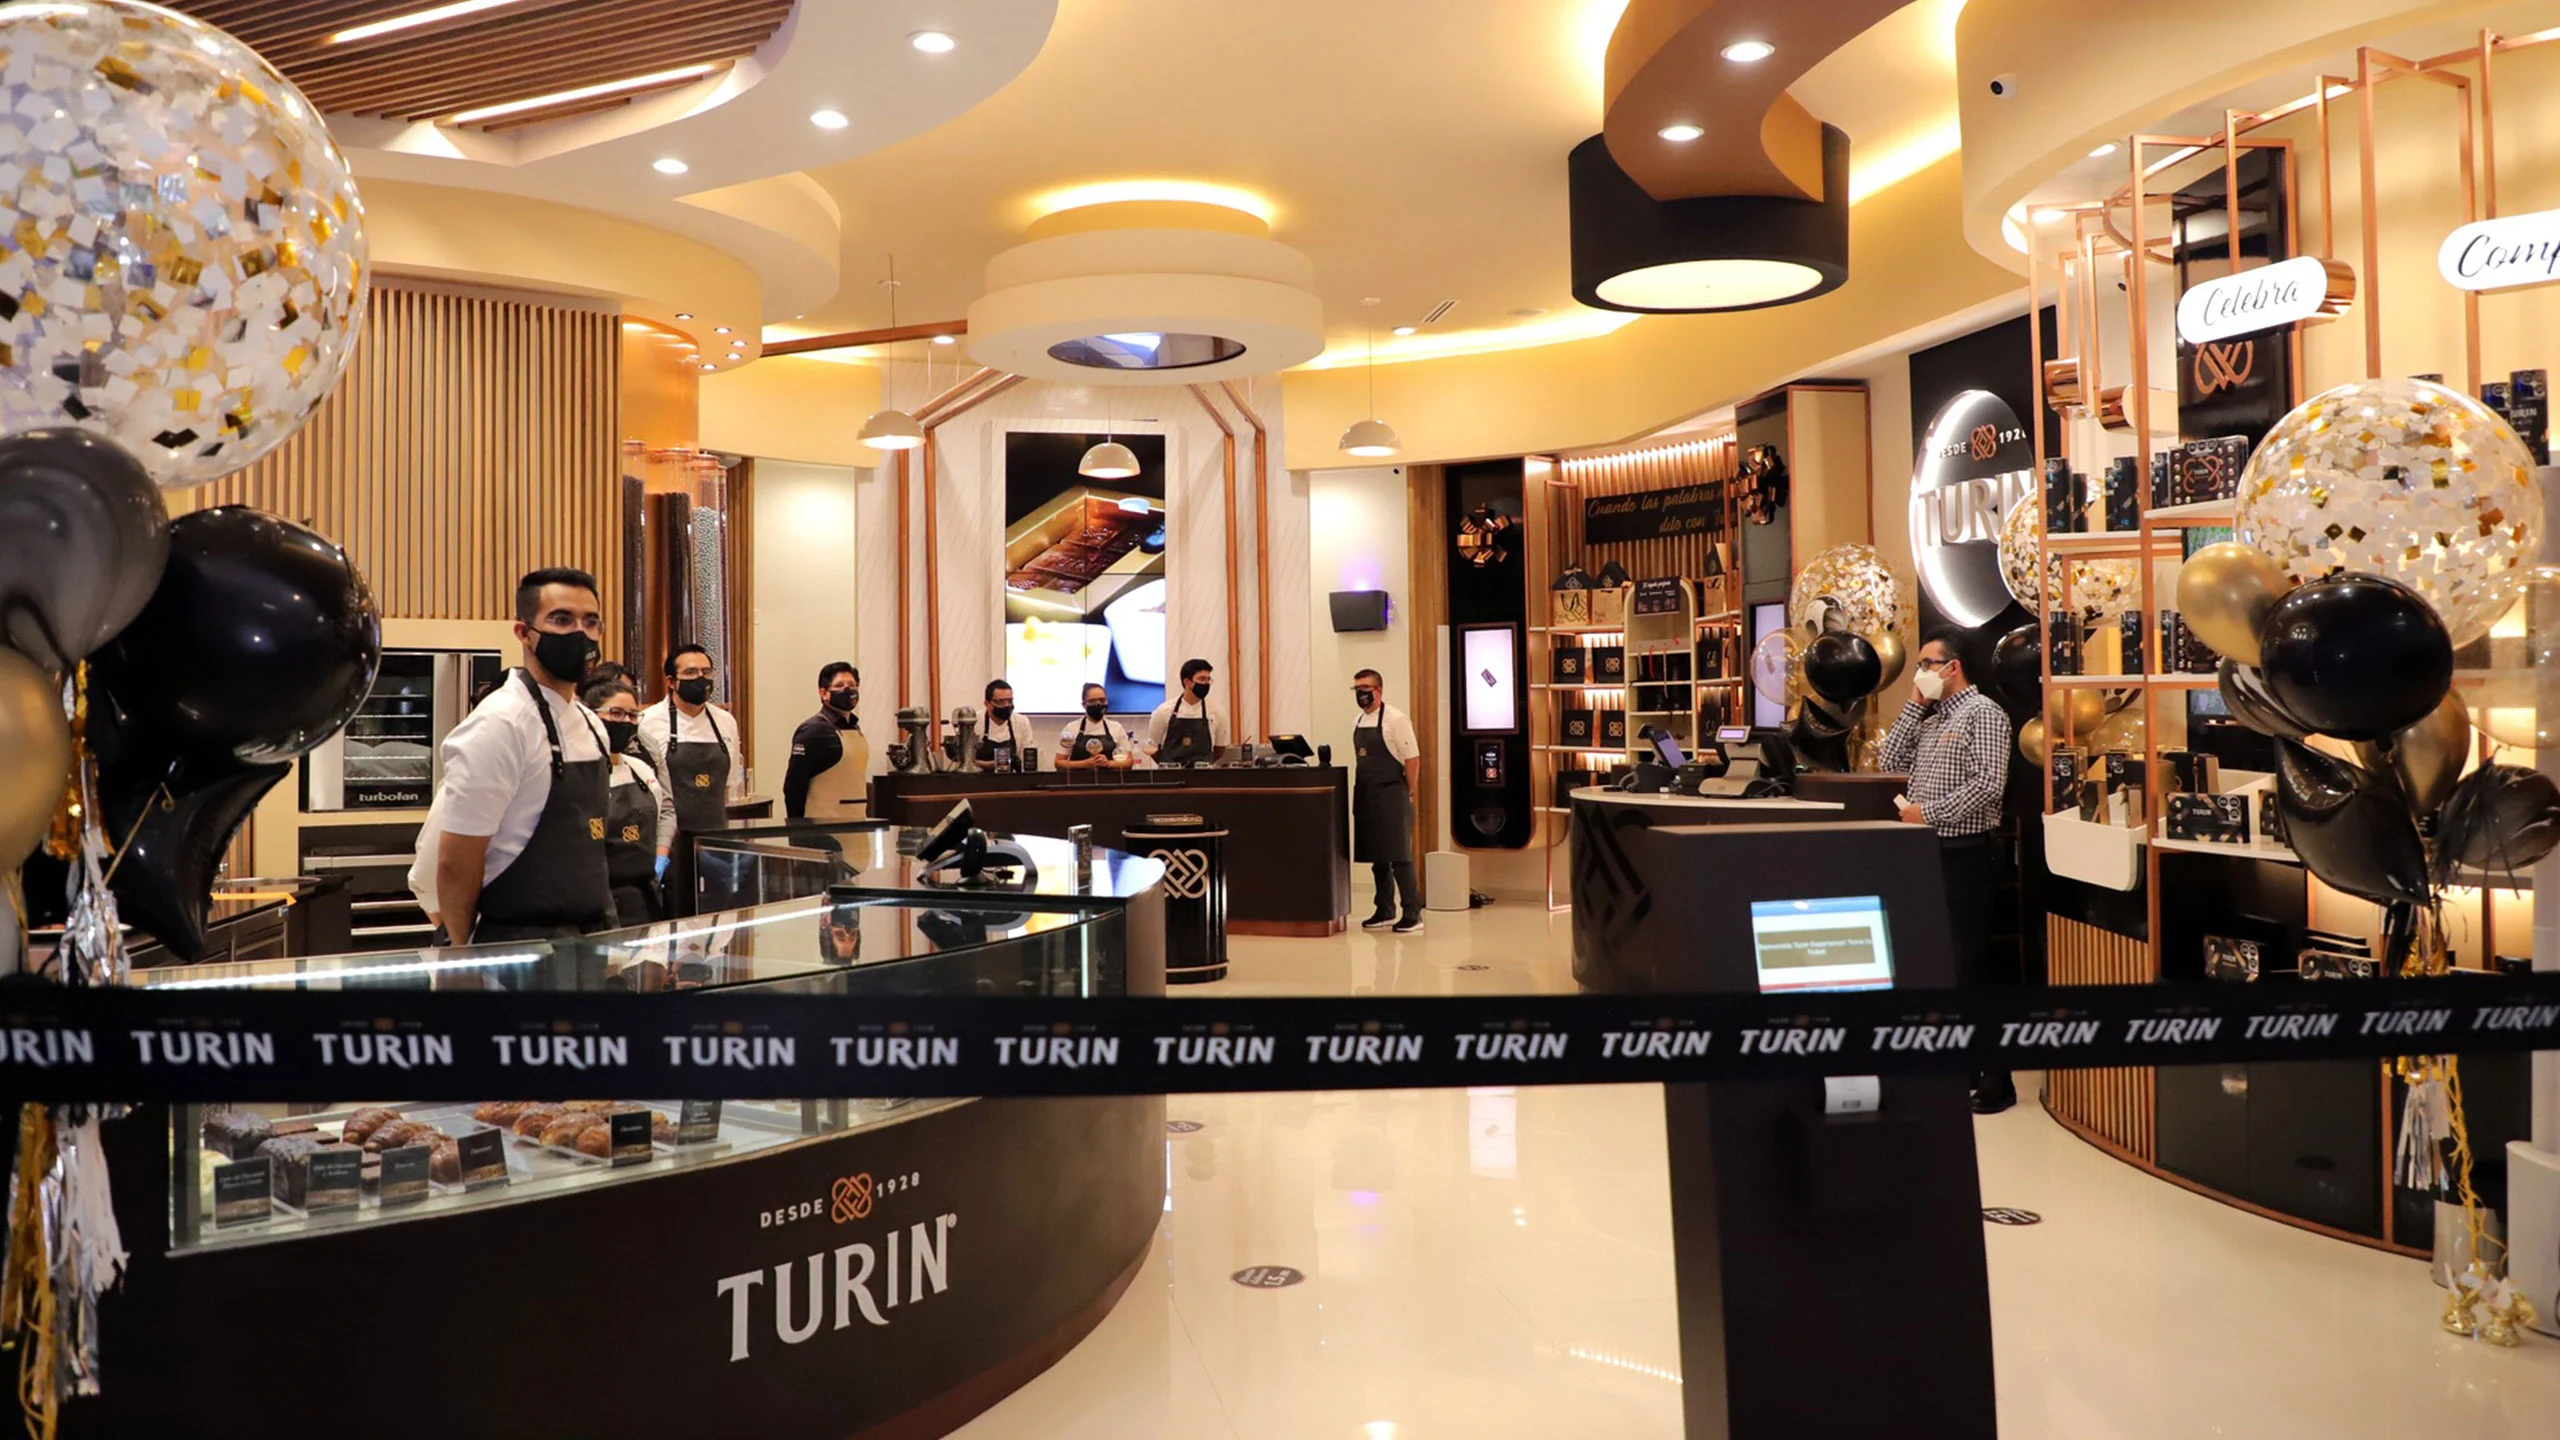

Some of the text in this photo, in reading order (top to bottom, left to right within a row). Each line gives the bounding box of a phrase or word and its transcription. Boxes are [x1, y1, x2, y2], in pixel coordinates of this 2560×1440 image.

[2203, 279, 2299, 327] Celebra
[1940, 441, 1967, 459] ESDE
[1587, 496, 1636, 518] Cuando
[1641, 494, 1659, 511] las
[1658, 516, 1682, 534] dilo
[1685, 517, 1706, 529] con
[359, 791, 419, 802] turbofan
[131, 1031, 274, 1067] TURIN
[314, 1034, 453, 1068] TURIN
[492, 1036, 628, 1069] TURIN
[663, 1037, 795, 1069] TURIN
[830, 1038, 958, 1069] TURIN
[994, 1038, 1119, 1068] TURIN
[1154, 1037, 1275, 1067] TURIN
[1306, 1036, 1423, 1065] TURIN
[1455, 1034, 1568, 1062] TURIN
[1602, 1031, 1711, 1059] TURIN
[1740, 1028, 1846, 1055] TURIN
[1872, 1026, 1974, 1052] TURIN
[2000, 1022, 2100, 1047] TURIN
[2125, 1018, 2221, 1043] TURIN
[2245, 1015, 2337, 1039] TURIN
[2361, 1010, 2451, 1035] TURIN
[2472, 1006, 2560, 1031] TURIN
[760, 1171, 921, 1228] DESDE 1928
